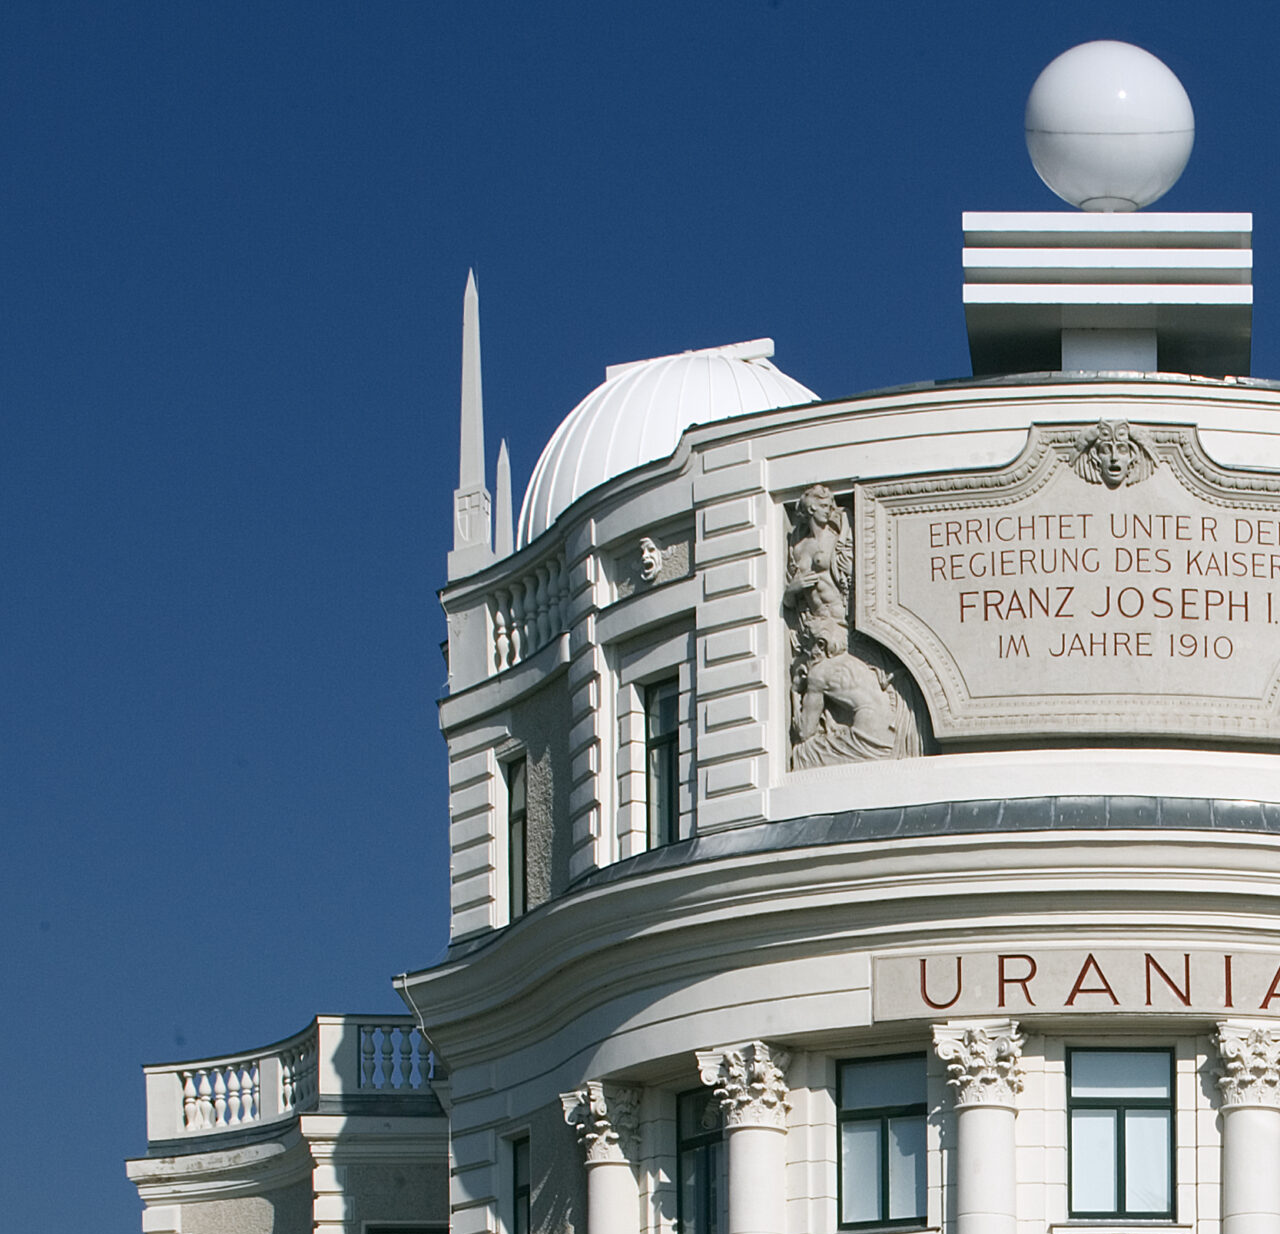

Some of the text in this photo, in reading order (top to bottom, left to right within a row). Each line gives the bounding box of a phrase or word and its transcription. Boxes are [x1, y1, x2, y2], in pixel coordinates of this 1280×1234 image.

[928, 513, 1094, 548] ERRICHTET
[1110, 513, 1218, 542] UNTER
[930, 548, 1100, 581] REGIERUNG
[1114, 547, 1172, 574] DES
[958, 586, 1075, 623] FRANZ
[1091, 586, 1249, 623] JOSEPH
[998, 632, 1234, 660] IM JAHRE 1910
